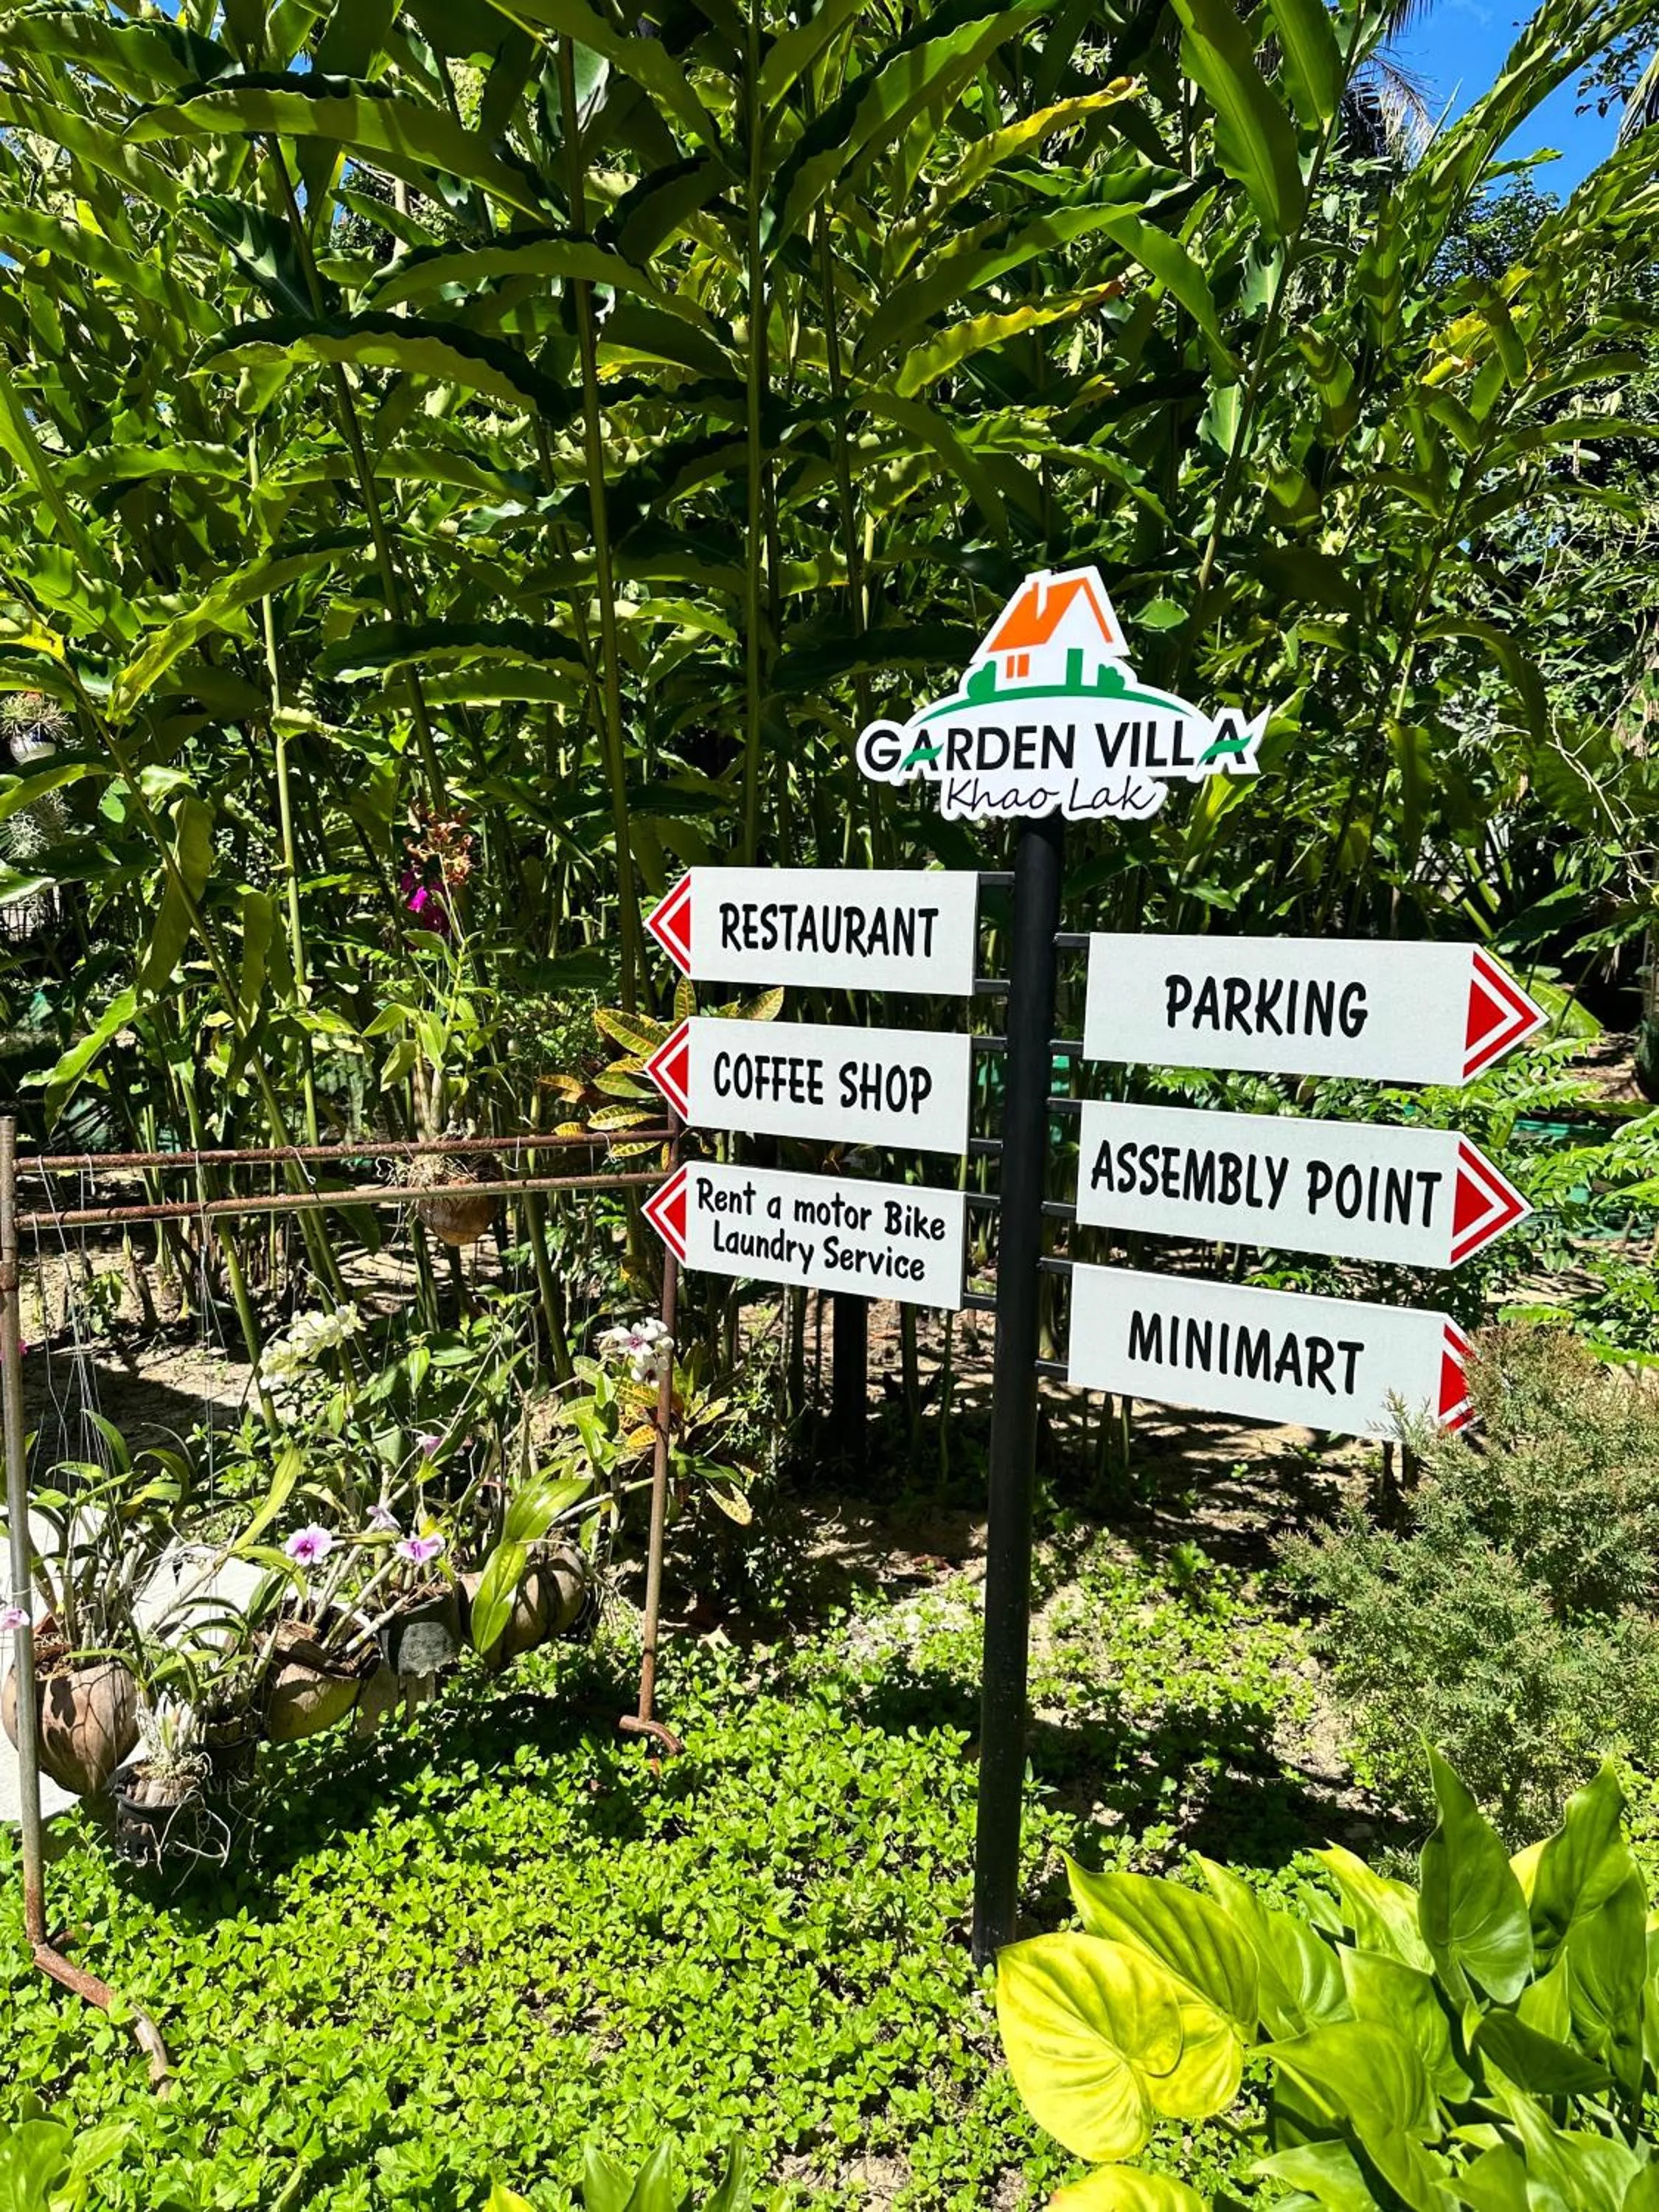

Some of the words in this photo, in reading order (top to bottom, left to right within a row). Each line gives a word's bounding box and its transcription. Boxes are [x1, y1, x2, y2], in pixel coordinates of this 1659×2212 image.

[864, 724, 1074, 772] GARDEN
[1096, 718, 1253, 769] VILLA
[945, 778, 1060, 811] Khao
[1068, 774, 1157, 812] Lak
[719, 902, 939, 958] RESTAURANT
[1164, 974, 1368, 1038] PARKING
[713, 1051, 824, 1105] COFFEE
[838, 1061, 933, 1114] SHOP
[696, 1178, 757, 1216] Rent
[767, 1196, 782, 1220] a
[793, 1192, 872, 1232] motor
[885, 1200, 946, 1241] Bike
[1091, 1139, 1289, 1211] ASSEMBLY
[1307, 1160, 1442, 1228] POINT
[713, 1220, 815, 1275] Laundry
[824, 1236, 925, 1281] Service
[1127, 1310, 1365, 1397] MINIMART
